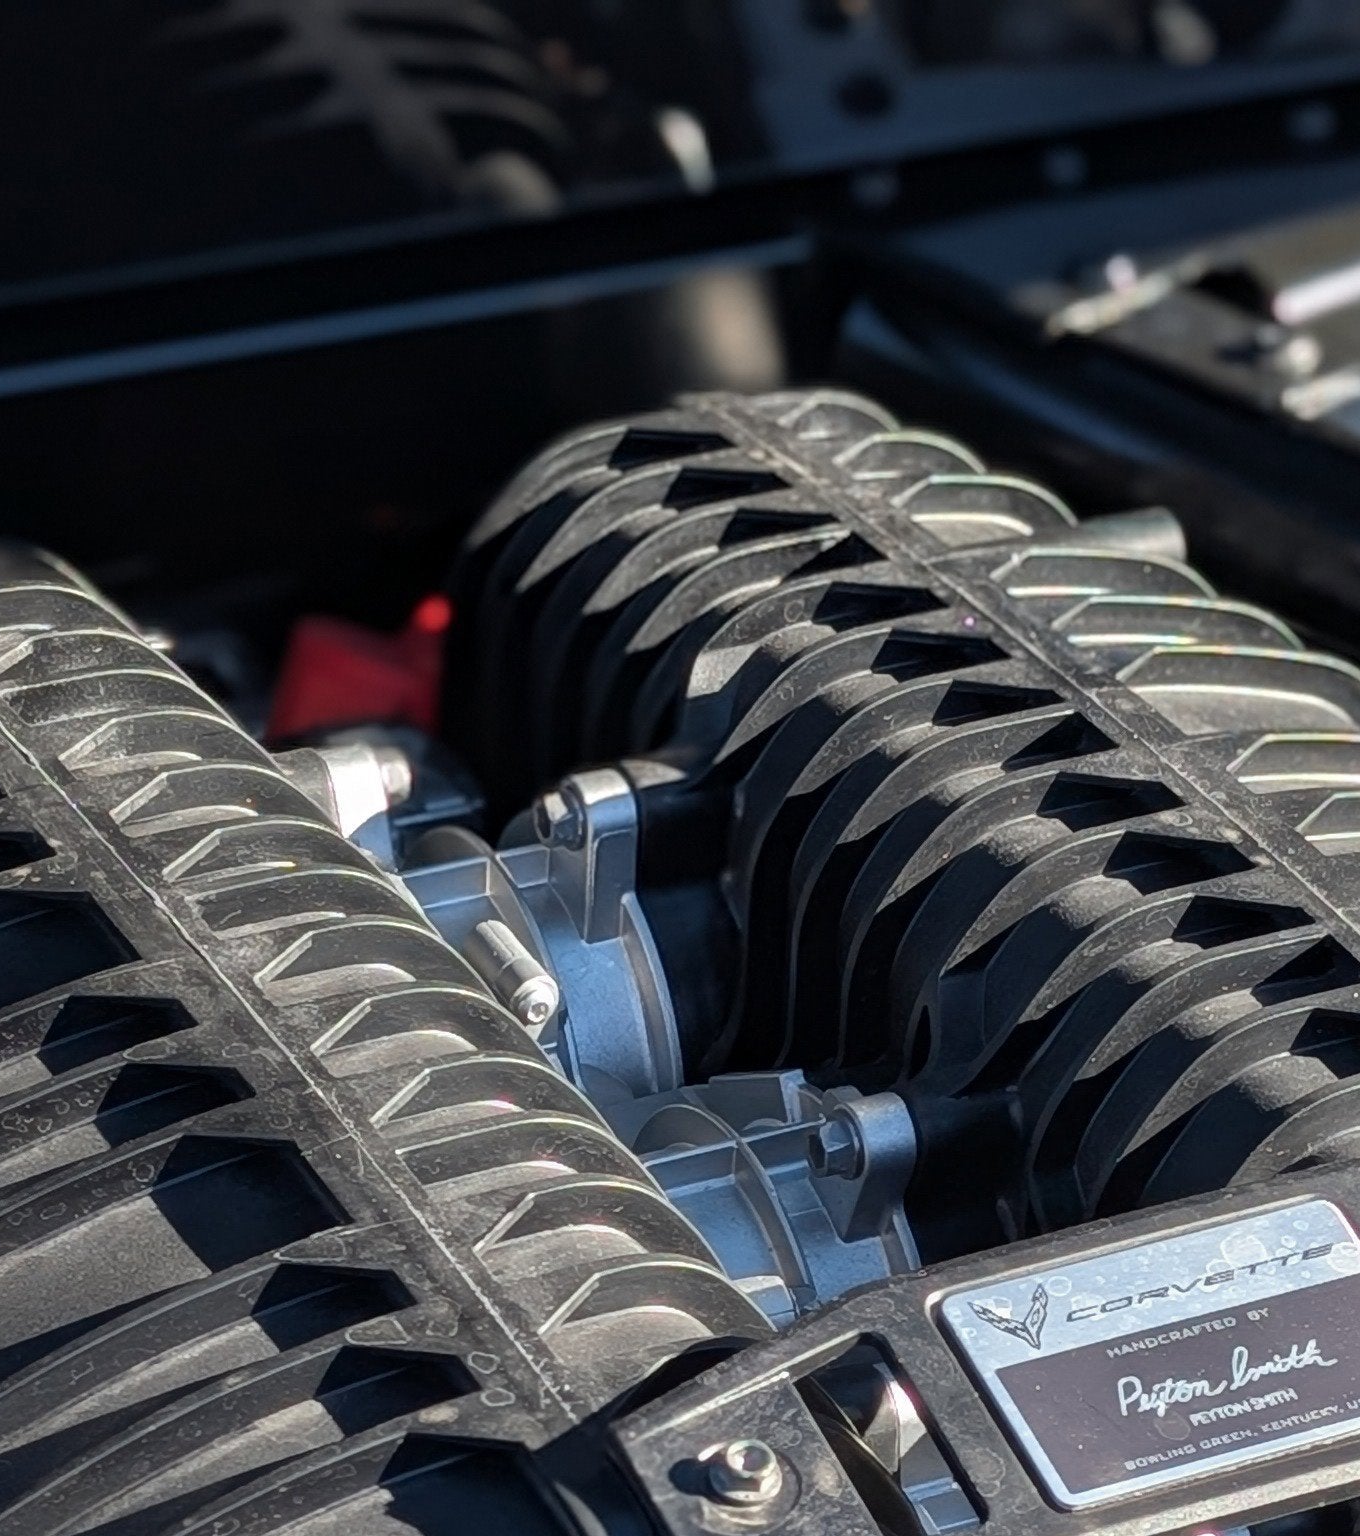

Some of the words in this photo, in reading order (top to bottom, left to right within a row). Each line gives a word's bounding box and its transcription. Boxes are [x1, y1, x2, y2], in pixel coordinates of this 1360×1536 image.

[1066, 1242, 1334, 1323] CORVETTE
[1106, 1316, 1237, 1359] HANDCRAFTED
[1246, 1307, 1270, 1321] BY
[1189, 1400, 1252, 1427] PEYTON
[1252, 1387, 1299, 1411] SMITH
[1124, 1443, 1196, 1471] BOWLING
[1199, 1428, 1259, 1450] GREEN,
[1261, 1404, 1344, 1433] KENTUCKY,
